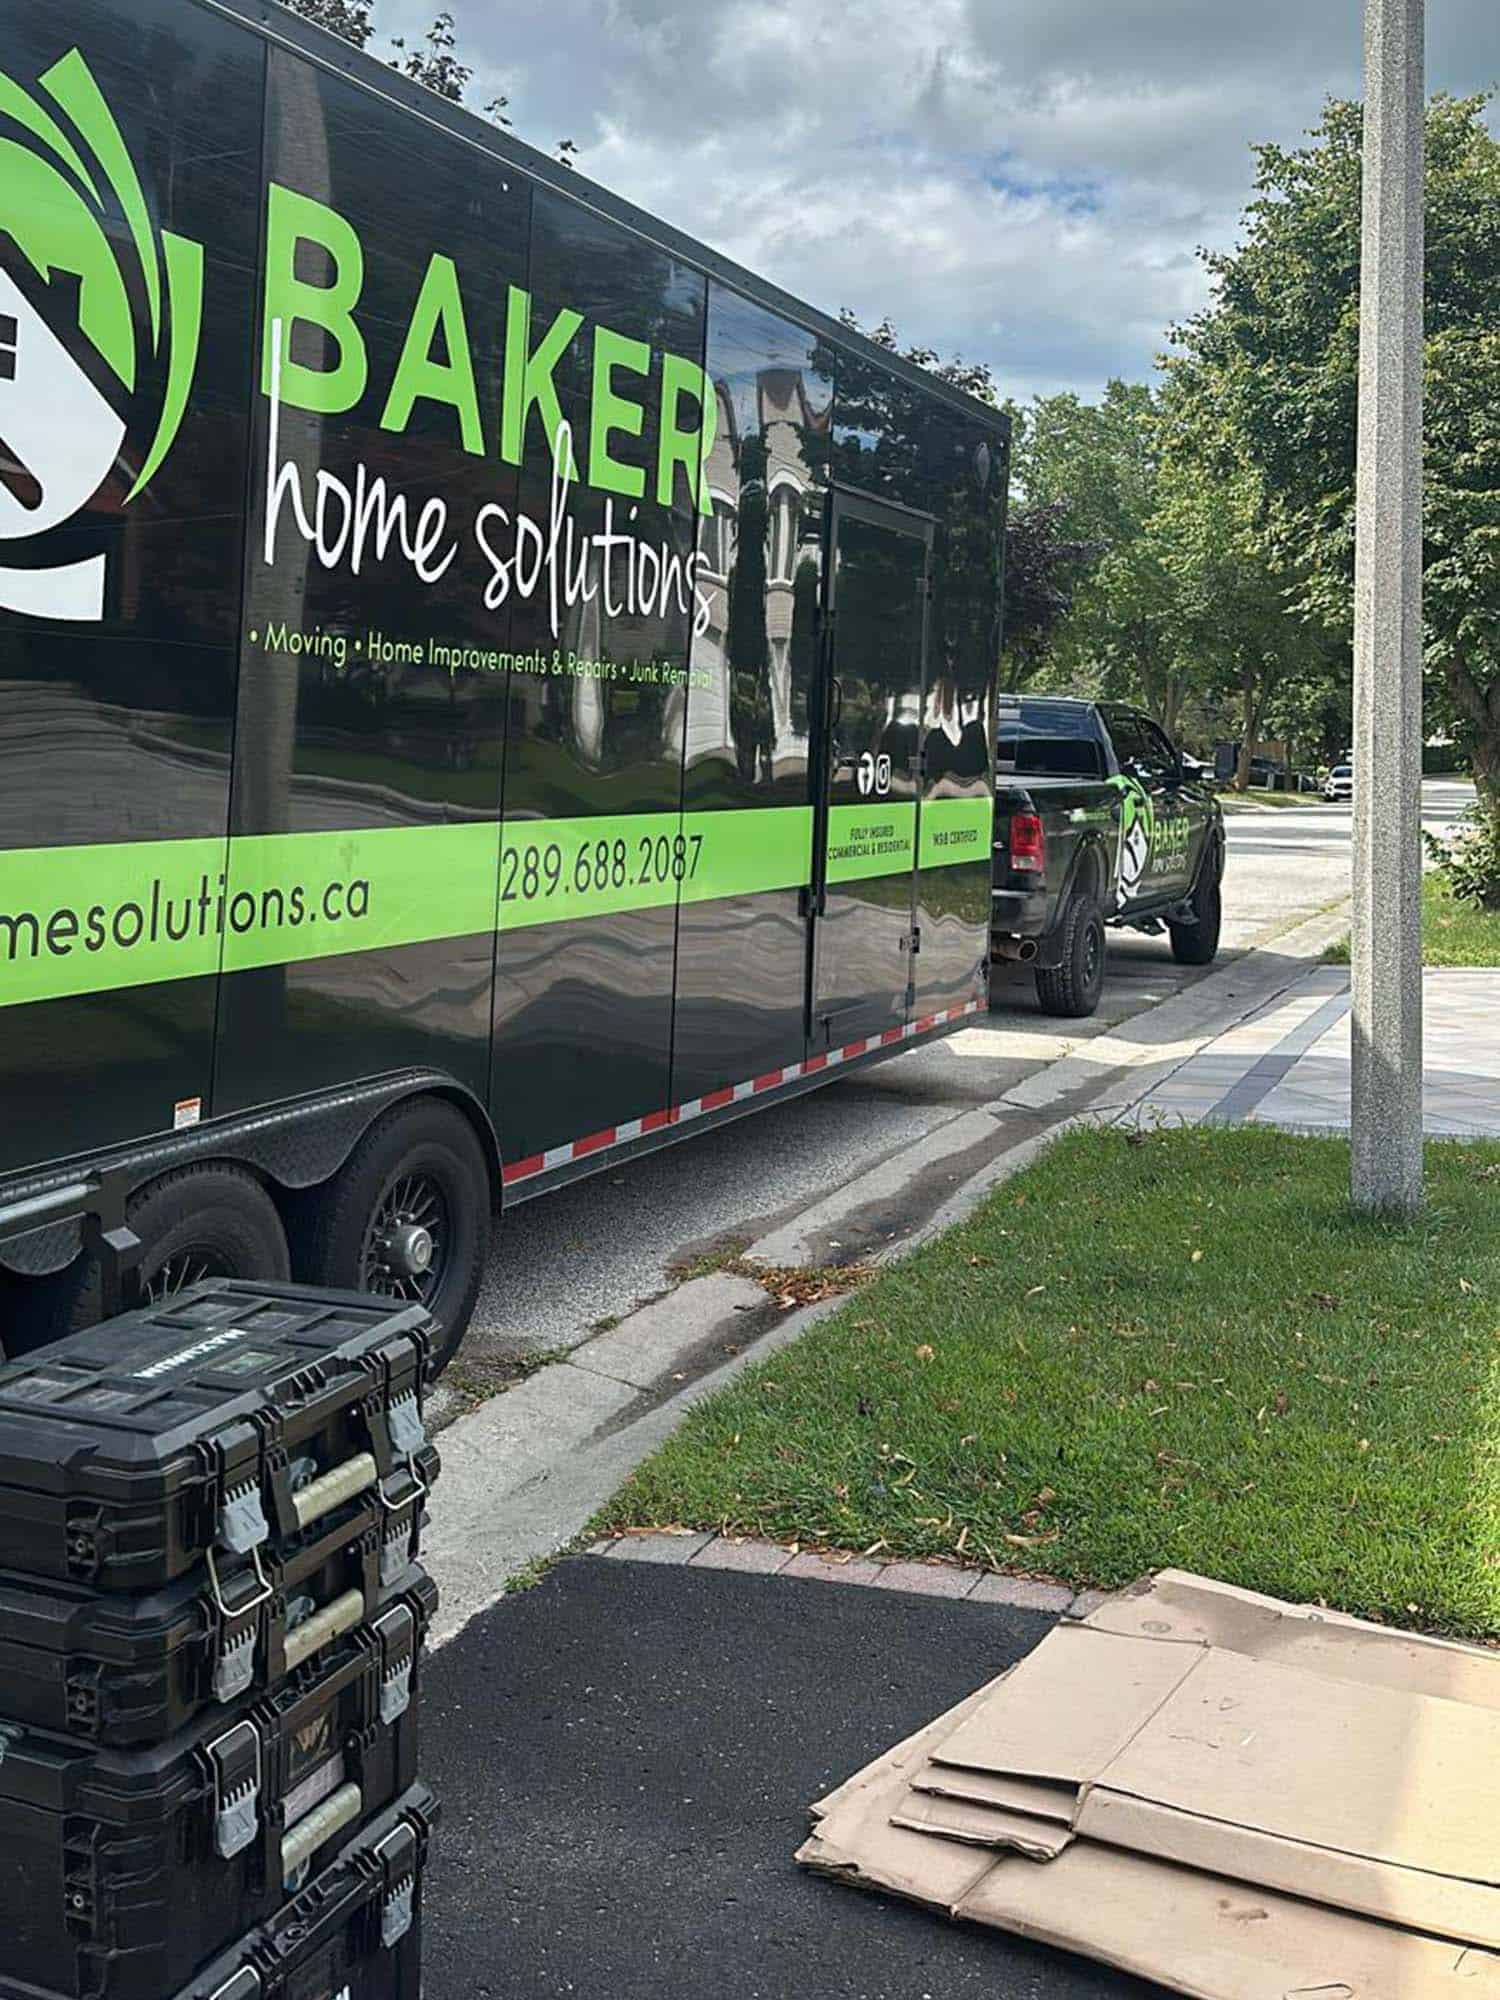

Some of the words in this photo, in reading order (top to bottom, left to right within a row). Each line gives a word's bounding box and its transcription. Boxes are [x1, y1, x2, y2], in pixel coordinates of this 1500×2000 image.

[261, 182, 717, 516] BAKER
[264, 318, 457, 584] home
[475, 420, 716, 638] solutions
[264, 621, 347, 668] Moving
[368, 631, 424, 664] Home
[428, 638, 547, 677] Improvements
[551, 650, 563, 676] &
[567, 652, 617, 681] Repairs
[629, 658, 659, 683] Junk
[501, 835, 702, 902] 289.688.2087
